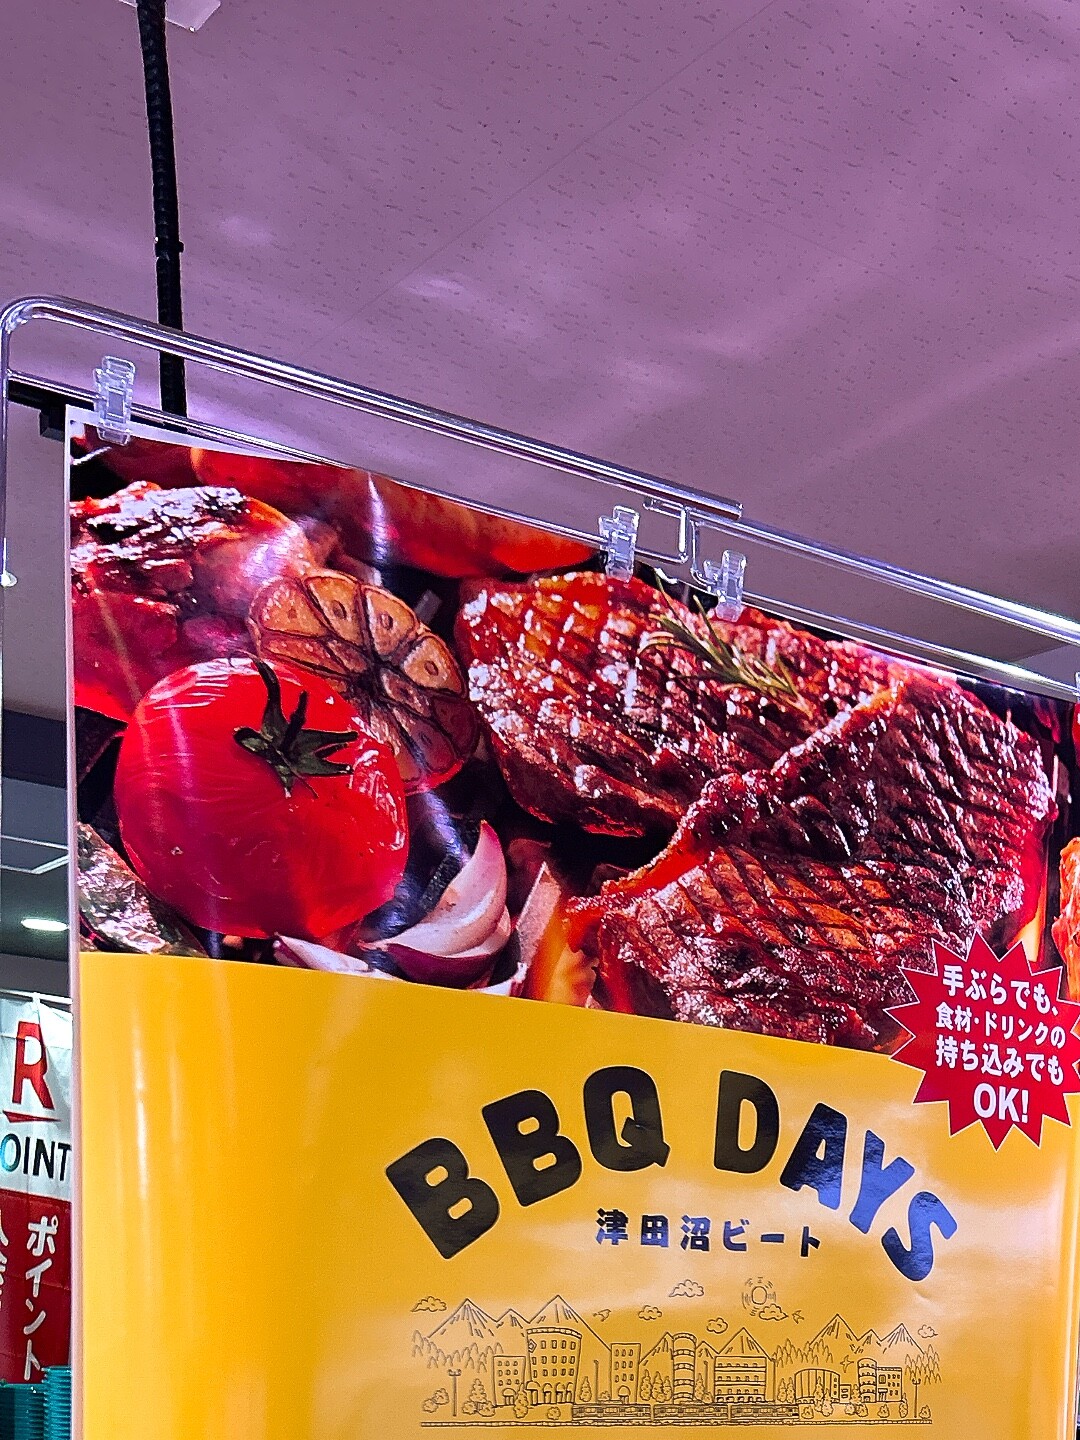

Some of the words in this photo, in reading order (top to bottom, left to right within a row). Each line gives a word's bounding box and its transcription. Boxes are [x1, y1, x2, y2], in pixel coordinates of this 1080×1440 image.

[942, 965, 1058, 1016] 手ぶらでも、
[936, 1002, 1066, 1049] 食材・ドリンクの
[936, 1035, 1063, 1085] 持ち込みでも
[973, 1083, 1029, 1124] OK!
[386, 1066, 670, 1259] BBQ
[713, 1070, 958, 1282] DAYS
[595, 1207, 822, 1259] 津田沼ビート
[24, 1215, 59, 1381] ポイント
